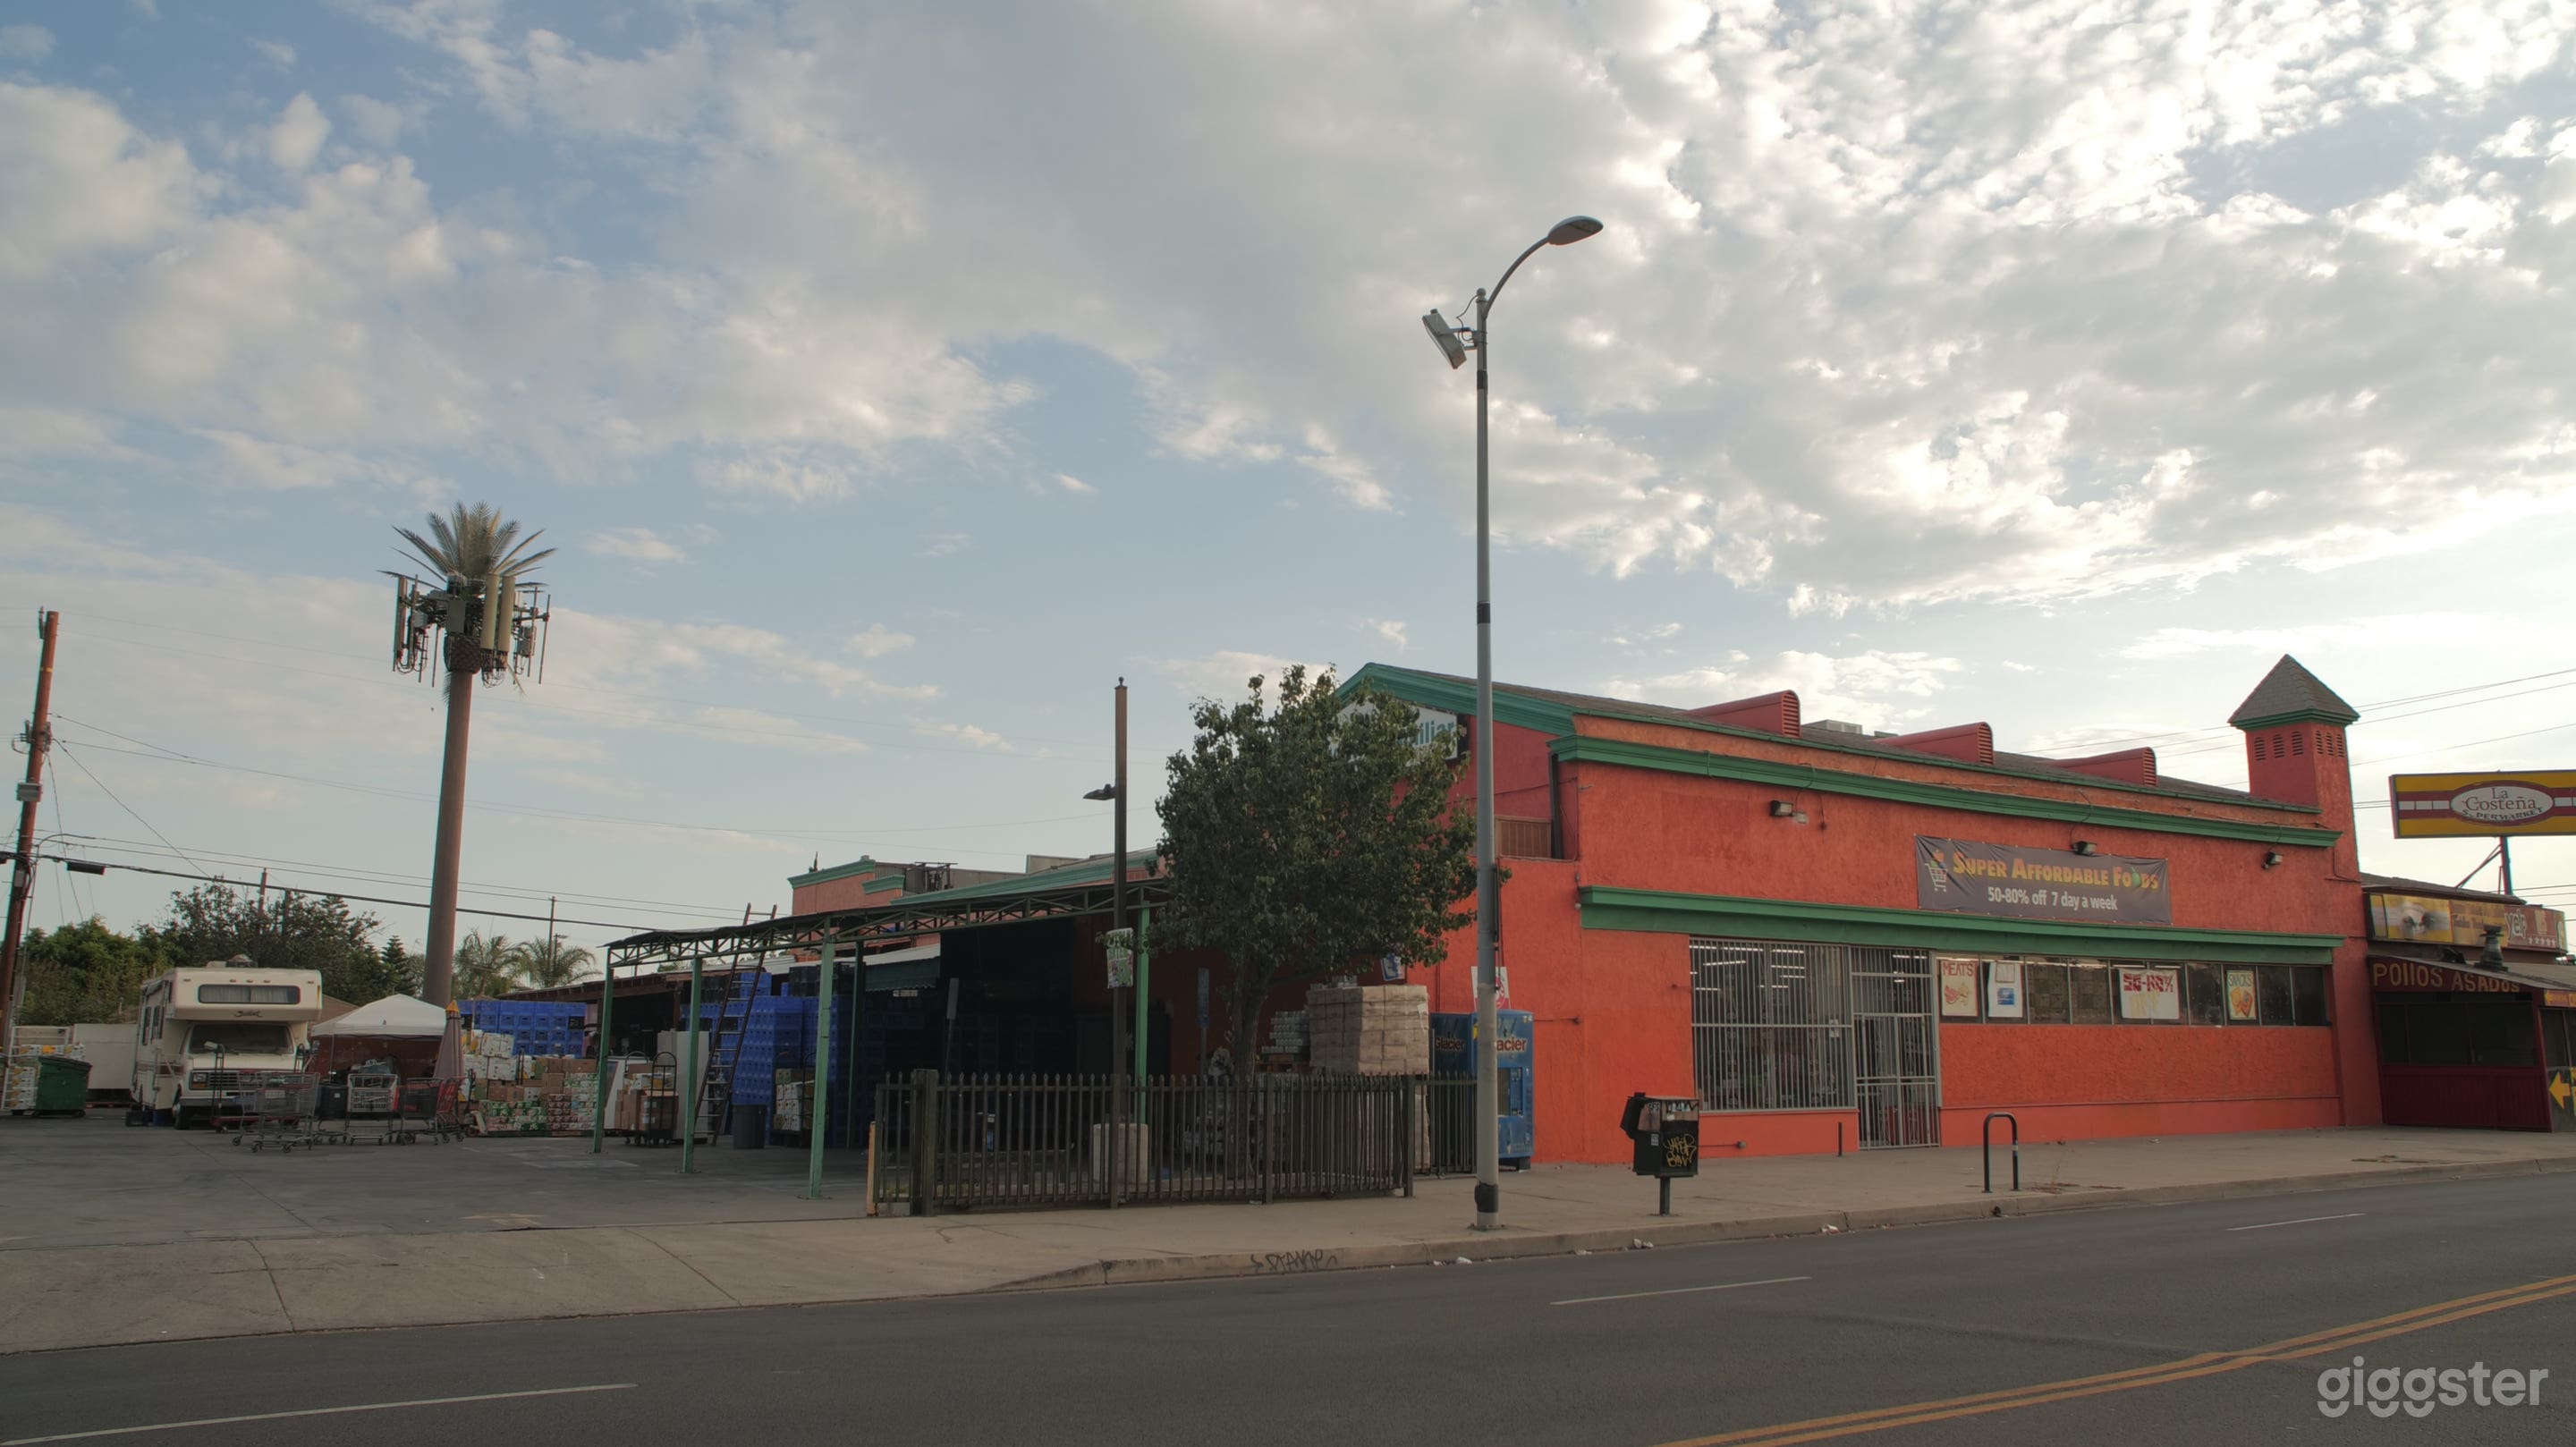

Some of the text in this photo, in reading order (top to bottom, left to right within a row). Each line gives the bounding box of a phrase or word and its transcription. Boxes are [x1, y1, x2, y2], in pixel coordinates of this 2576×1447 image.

[2492, 787, 2508, 799] La
[2463, 796, 2537, 811] Costeña
[1953, 851, 2007, 878] SUPER
[2012, 858, 2108, 886] AFFORDABLE
[1987, 886, 2118, 910] 50-80% off 7 day a week
[2504, 909, 2528, 940] yelp
[1943, 961, 1974, 977] MEATS
[1436, 1037, 1464, 1050] Glacier
[1496, 1037, 1527, 1051] acier
